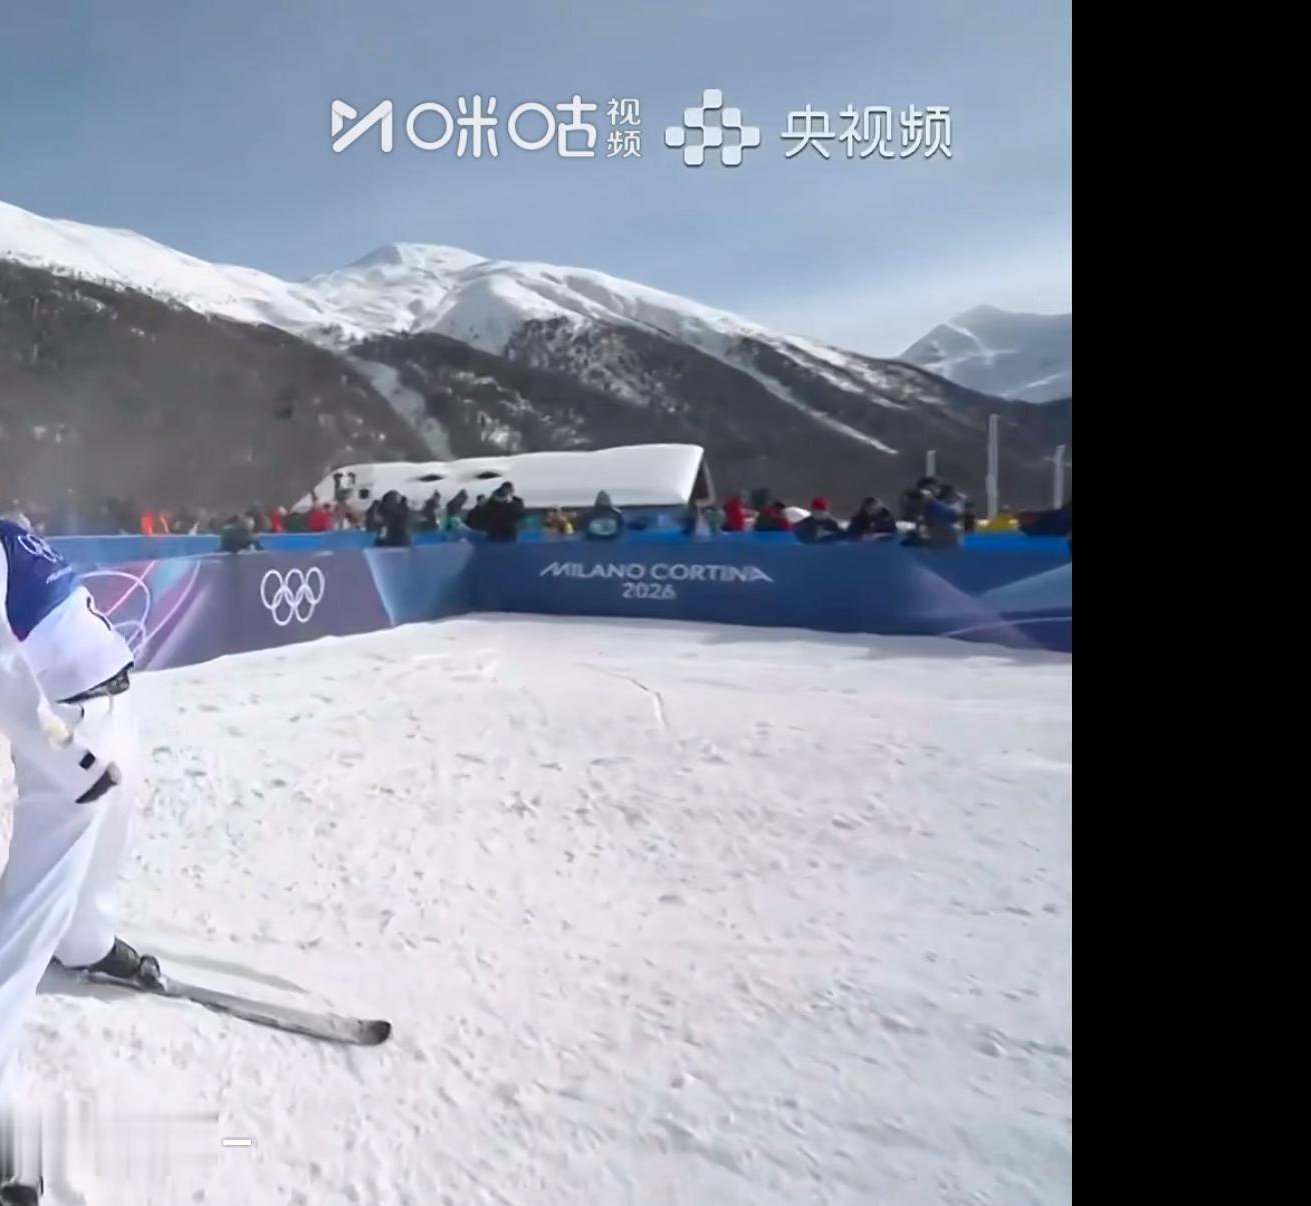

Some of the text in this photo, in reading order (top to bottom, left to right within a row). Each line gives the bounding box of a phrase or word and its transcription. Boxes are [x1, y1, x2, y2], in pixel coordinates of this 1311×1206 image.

[539, 561, 774, 582] MILANO CORTINA
[621, 582, 676, 600] 2026
